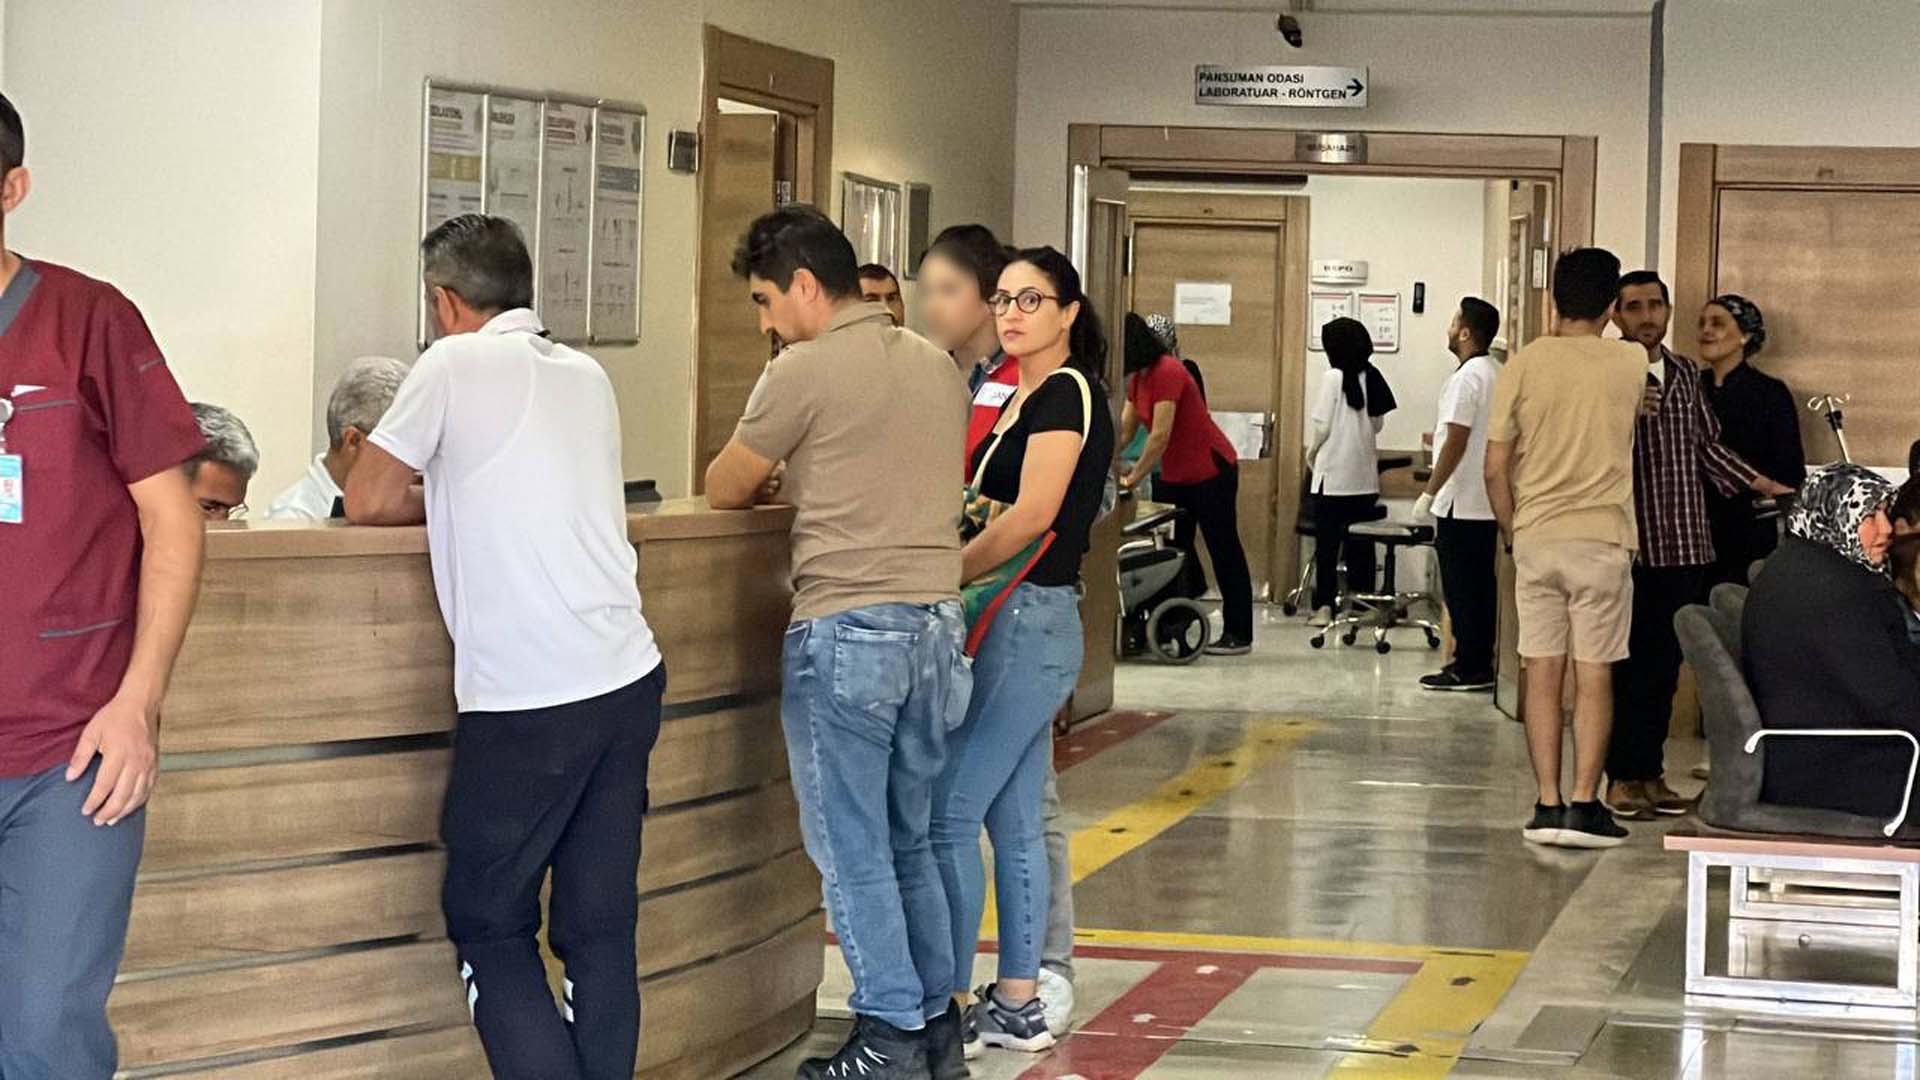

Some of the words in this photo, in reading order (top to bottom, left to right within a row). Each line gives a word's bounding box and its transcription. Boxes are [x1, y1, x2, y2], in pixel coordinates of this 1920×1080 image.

[1199, 72, 1264, 83] PANSUMAN
[1267, 73, 1304, 83] ODASI
[1199, 87, 1278, 97] LABORATUAR
